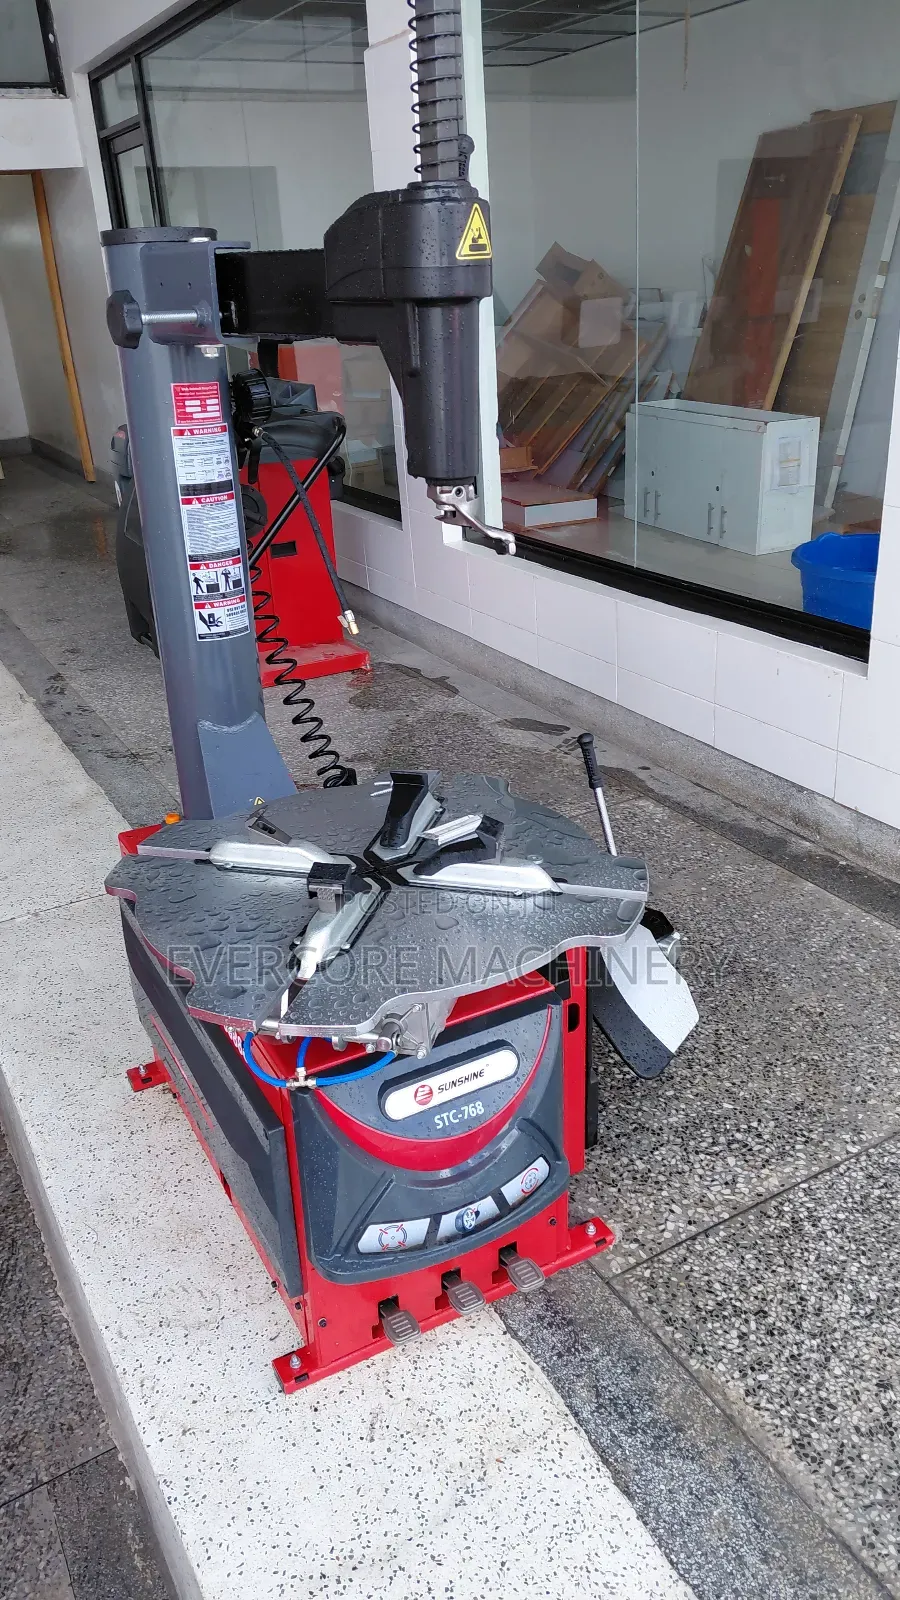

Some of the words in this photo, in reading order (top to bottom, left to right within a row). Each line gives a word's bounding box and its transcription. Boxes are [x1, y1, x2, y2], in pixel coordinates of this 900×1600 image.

[192, 426, 222, 435] WARNING
[201, 494, 228, 503] CAUTION
[208, 560, 233, 569] DANGER
[213, 598, 240, 608] WARNING
[437, 1068, 485, 1094] SUNSHINE
[434, 1100, 485, 1130] STC-768
